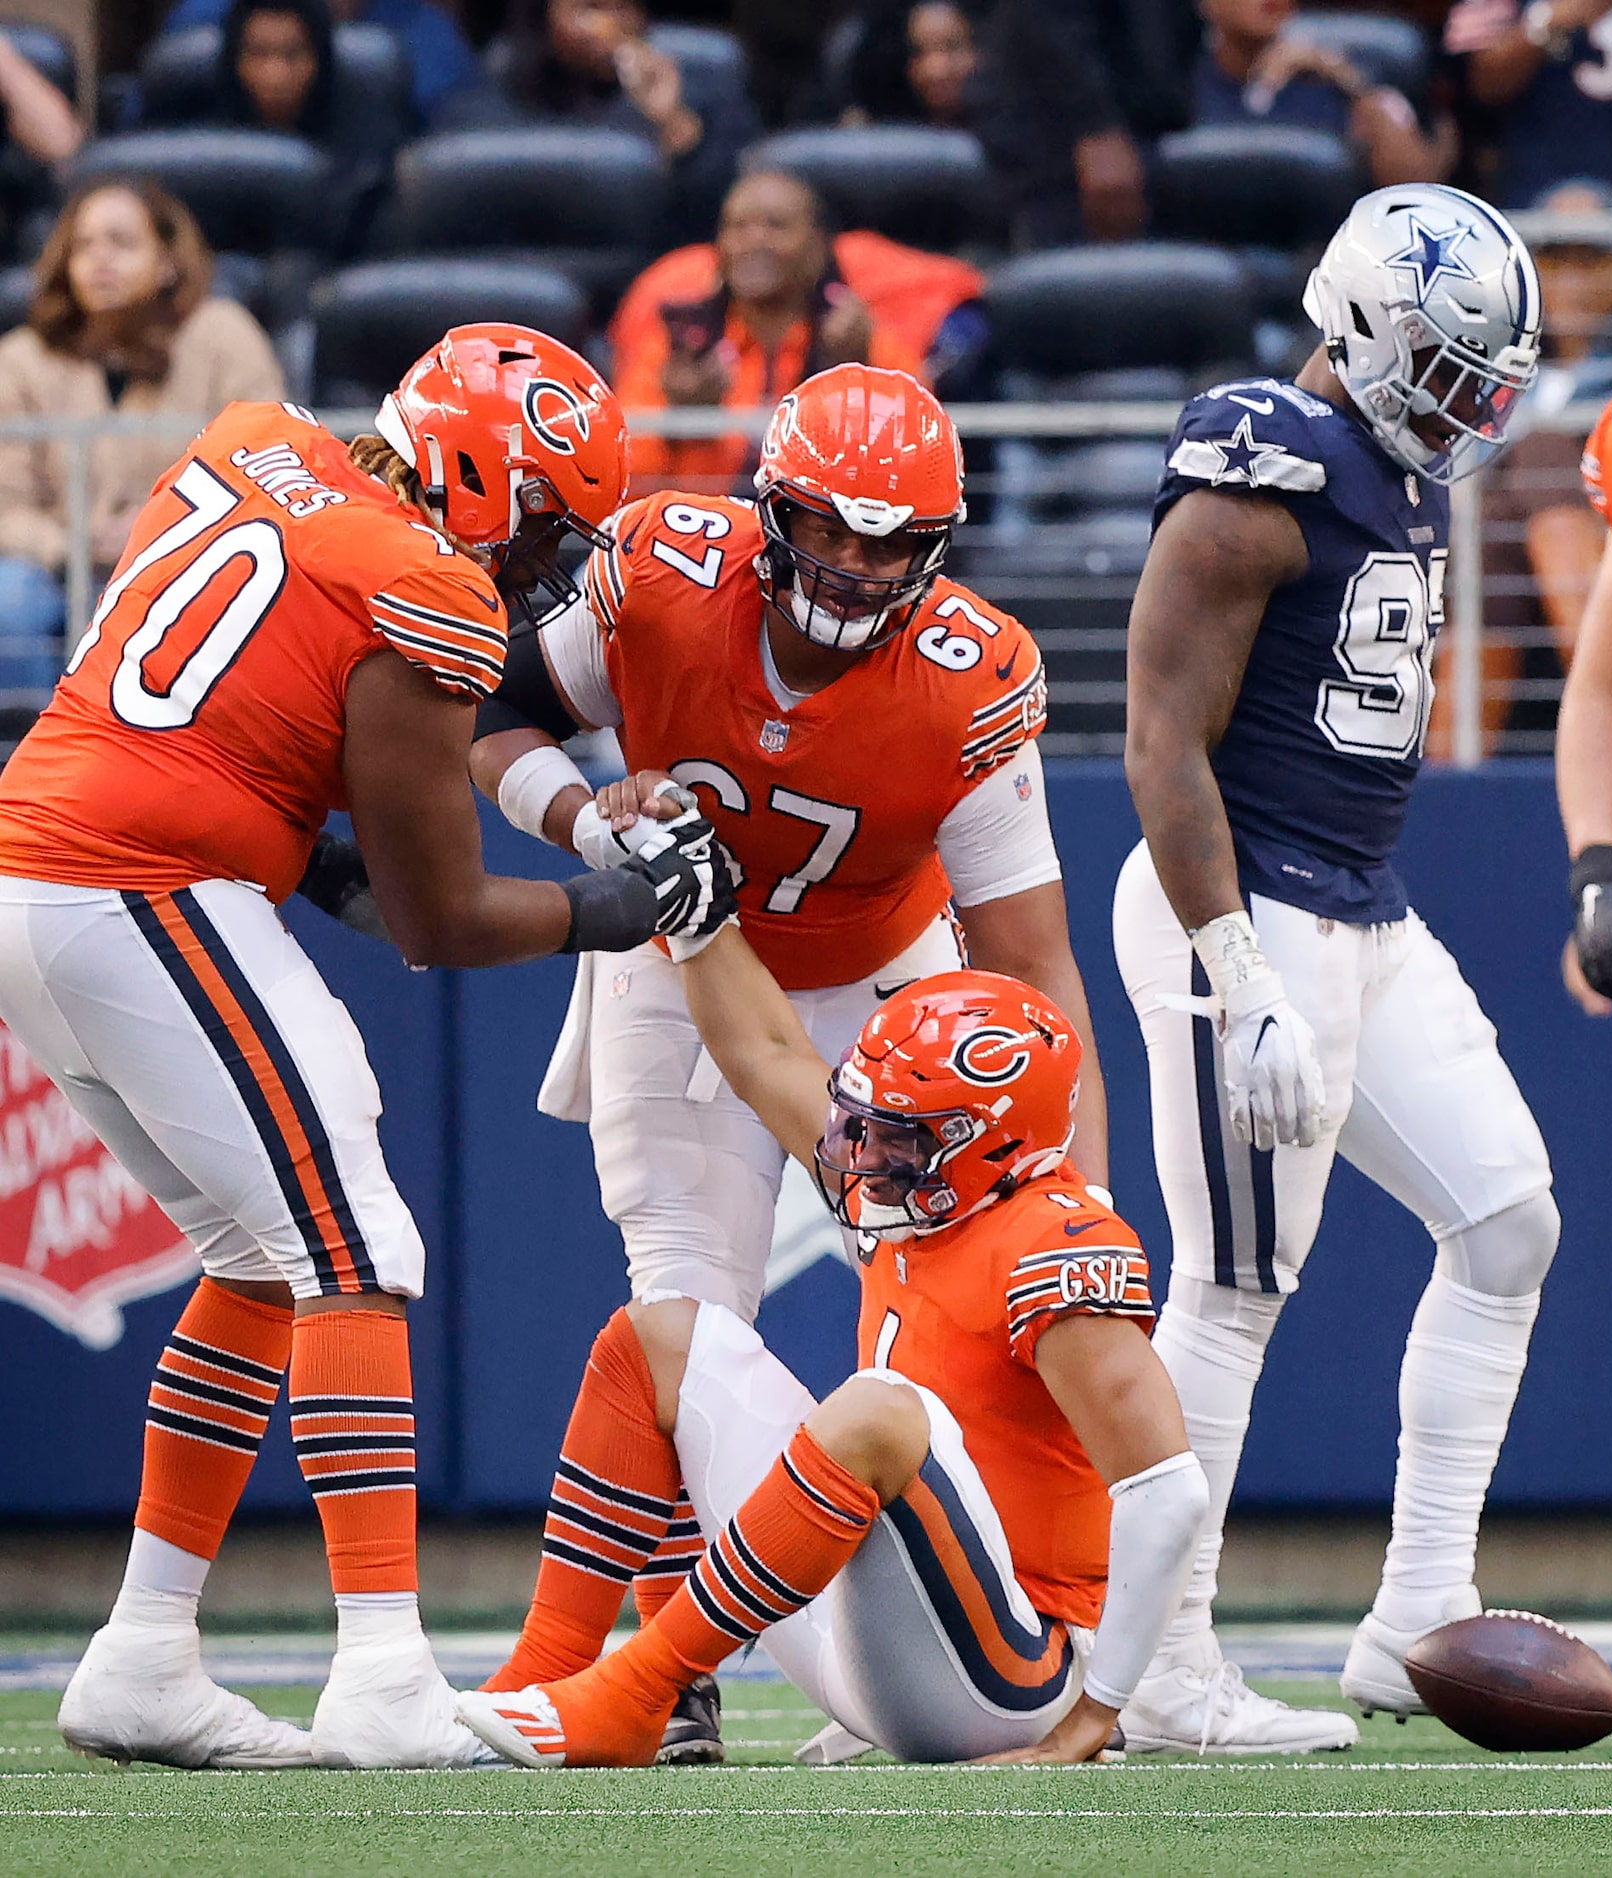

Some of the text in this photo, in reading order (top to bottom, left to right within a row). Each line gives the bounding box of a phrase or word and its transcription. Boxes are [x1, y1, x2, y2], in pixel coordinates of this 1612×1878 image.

[231, 442, 348, 518] JONES
[652, 501, 733, 589] 67
[63, 456, 288, 731] 70
[915, 594, 1002, 673] 67
[1060, 1255, 1129, 1304] GSH
